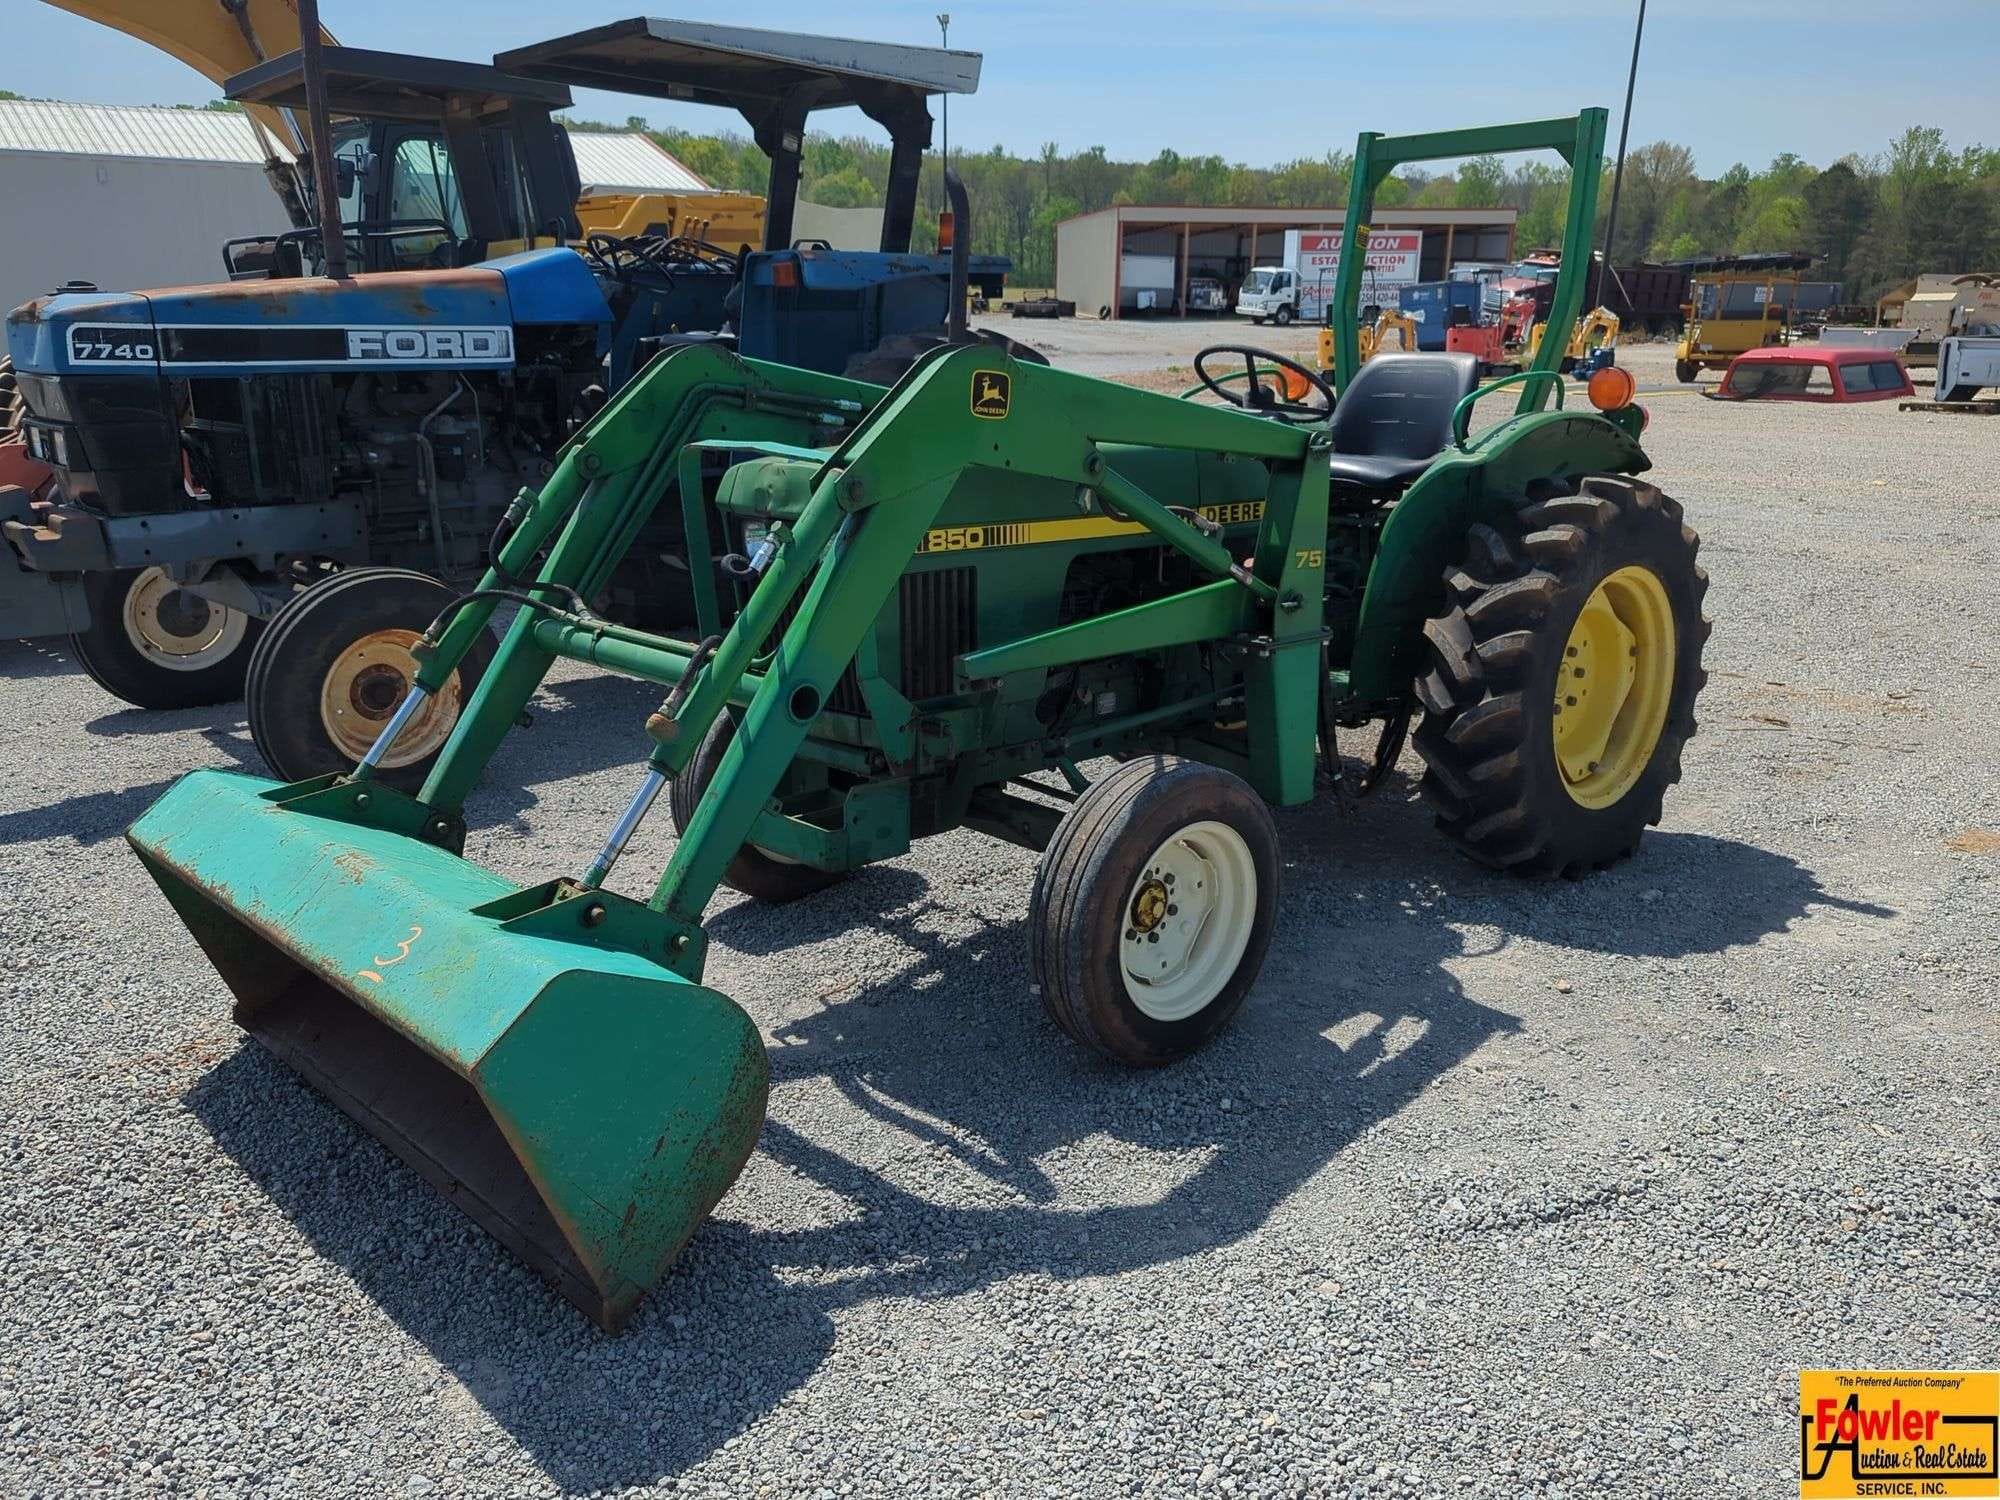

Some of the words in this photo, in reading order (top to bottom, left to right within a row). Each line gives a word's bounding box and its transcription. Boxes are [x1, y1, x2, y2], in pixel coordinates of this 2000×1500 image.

[1317, 238, 1400, 250] AUION
[75, 344, 153, 359] 7740
[347, 330, 501, 358] FORD
[928, 527, 984, 552] 850
[1206, 503, 1261, 522] DEERE
[1295, 550, 1322, 568] 75
